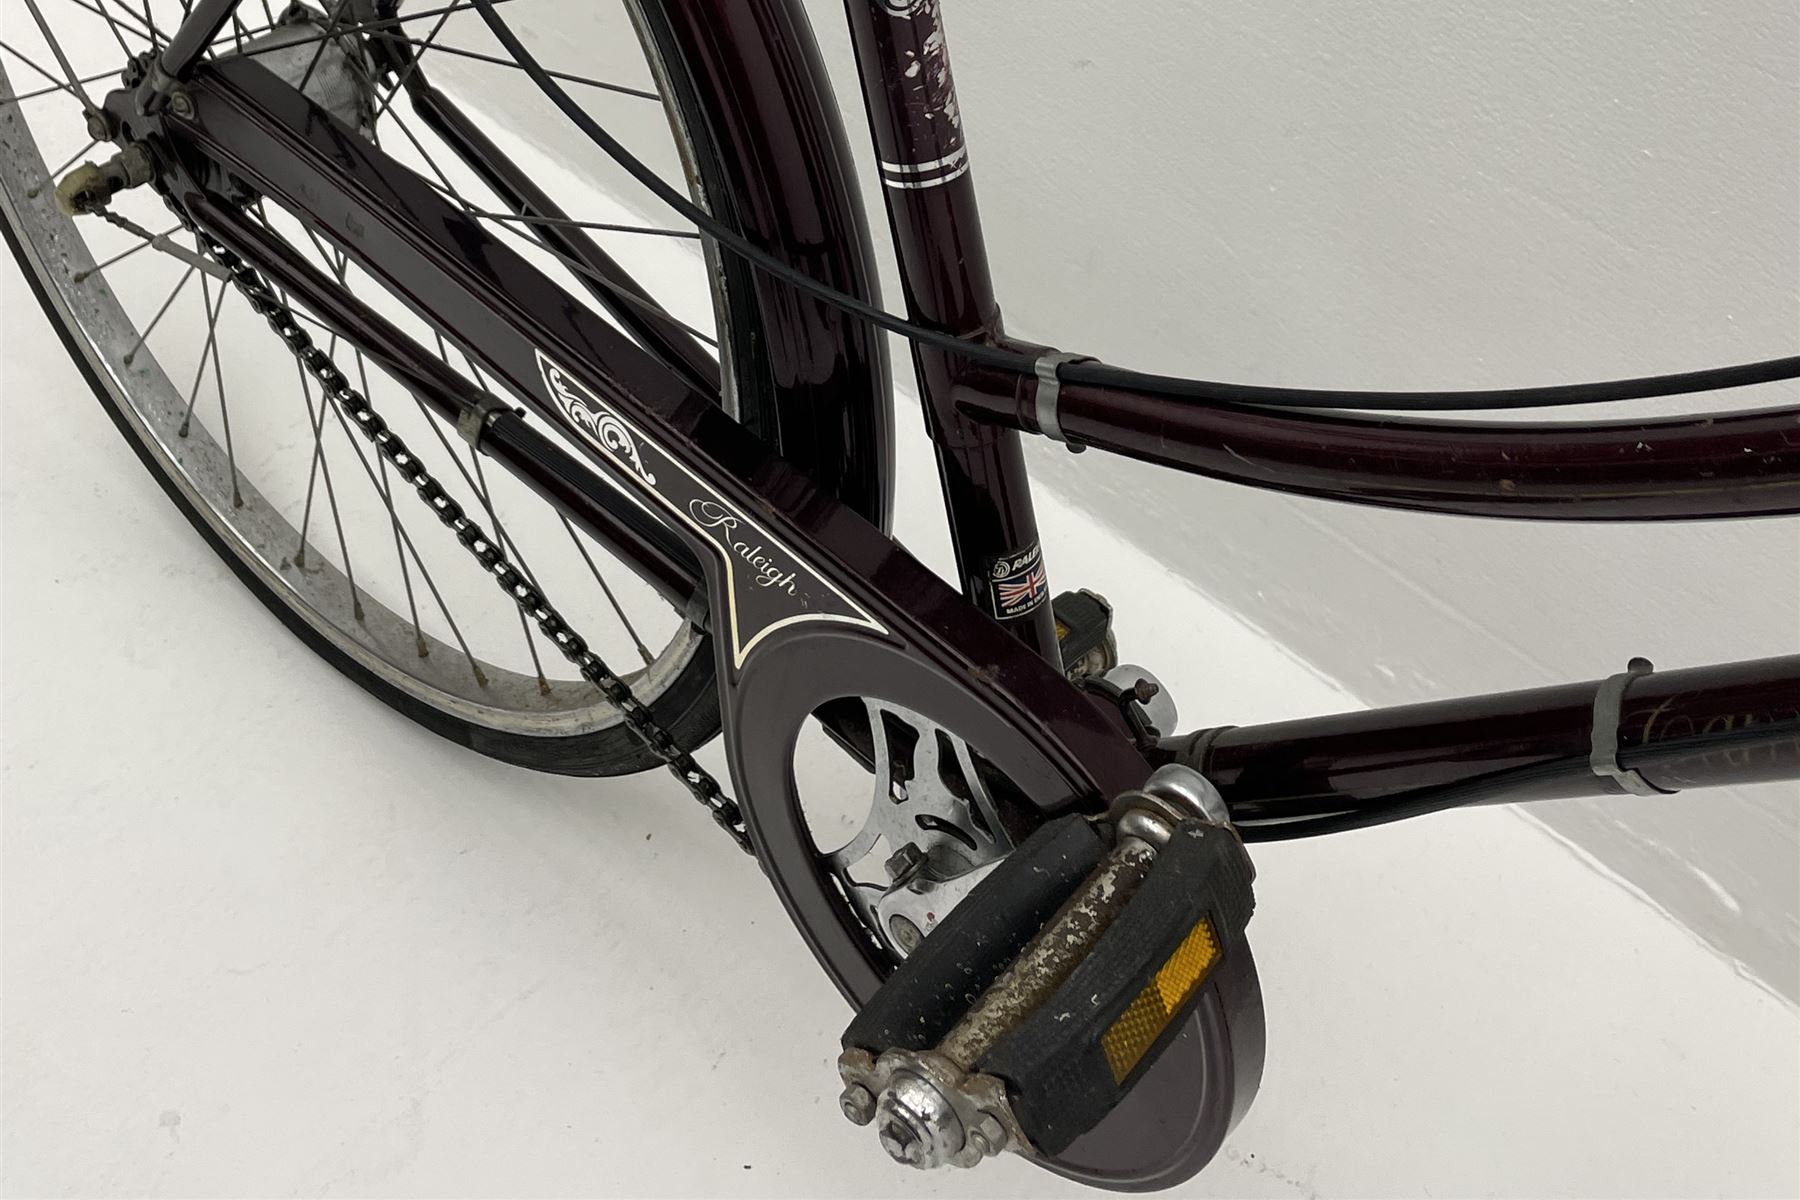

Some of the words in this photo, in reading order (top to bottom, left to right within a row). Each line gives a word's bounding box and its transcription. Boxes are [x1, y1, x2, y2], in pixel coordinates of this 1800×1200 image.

[689, 499, 797, 596] Raleigh
[1006, 603, 1026, 614] MADE
[1027, 600, 1034, 608] IN
